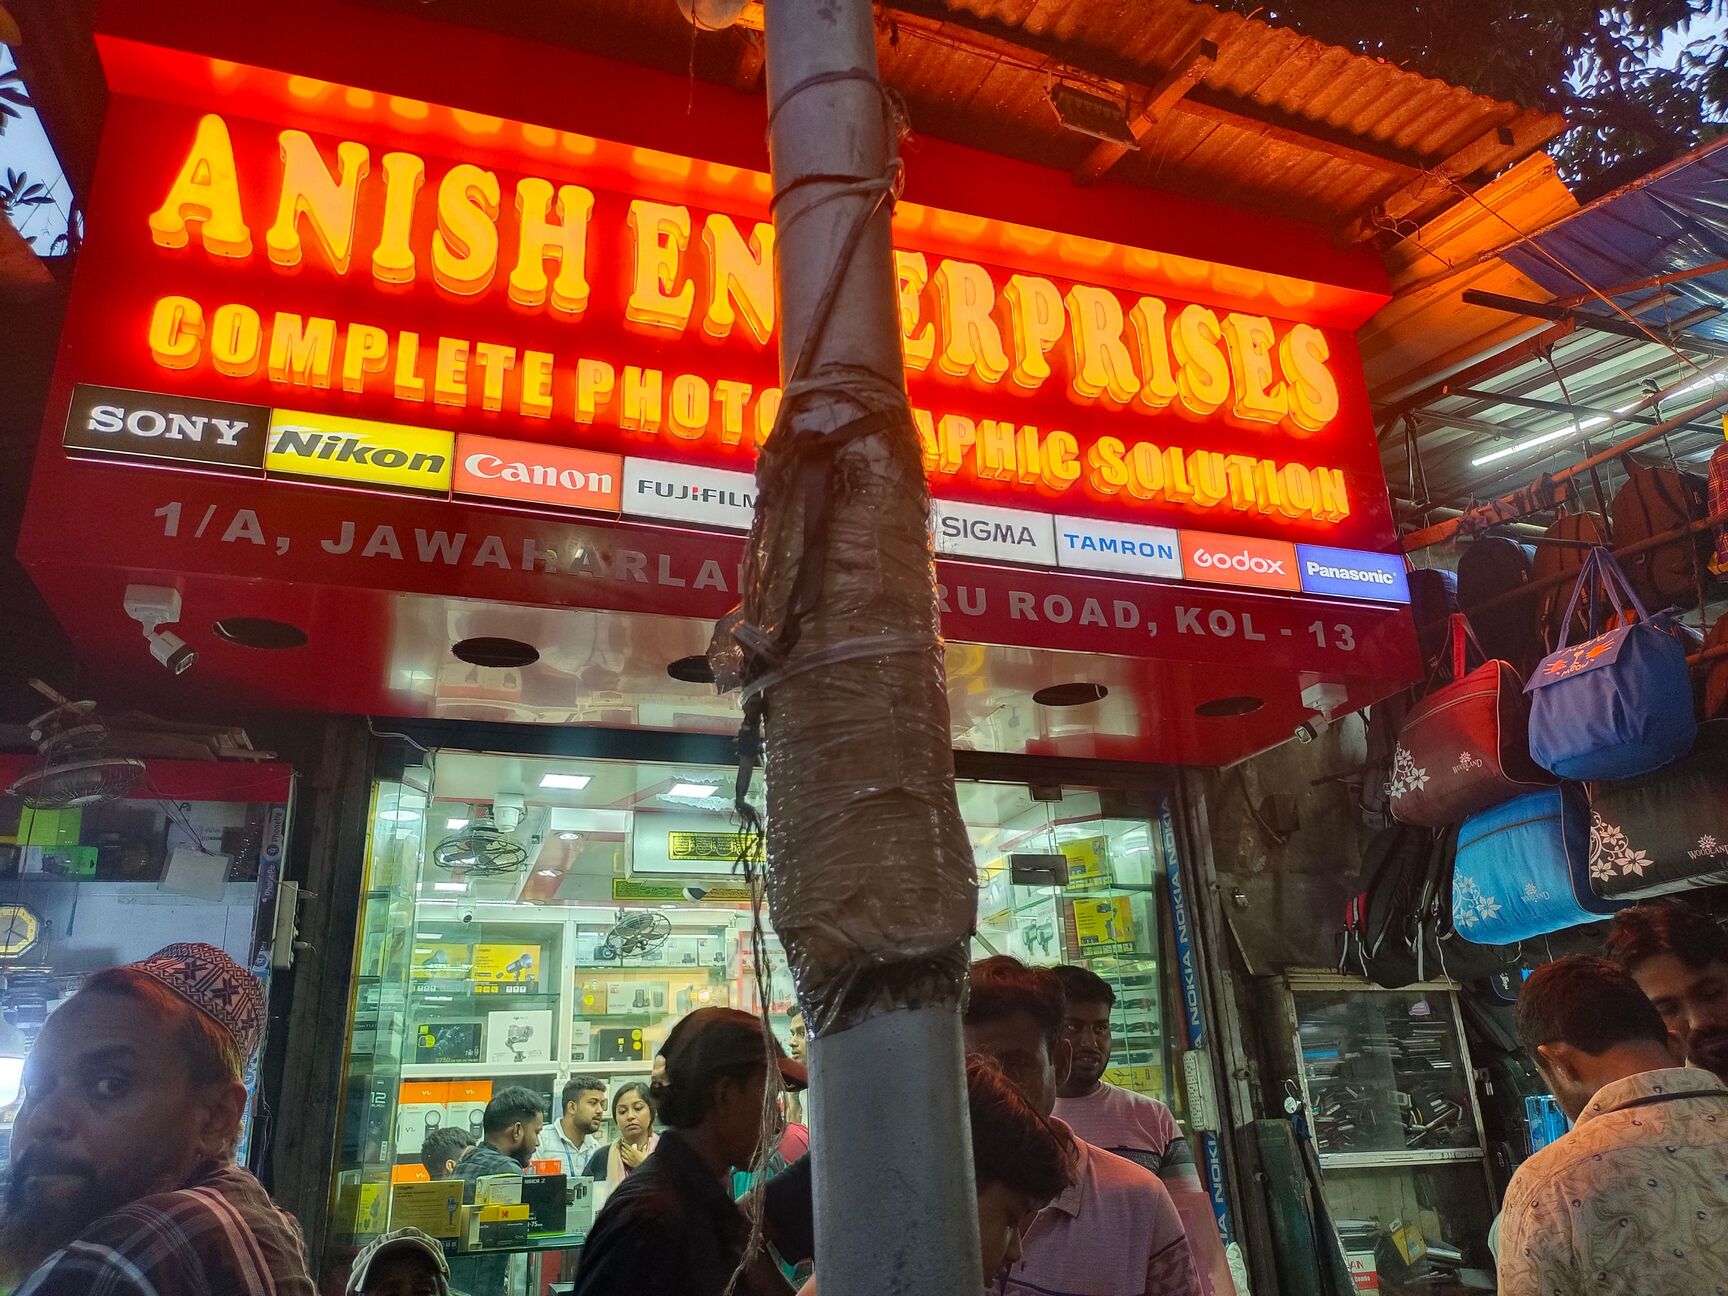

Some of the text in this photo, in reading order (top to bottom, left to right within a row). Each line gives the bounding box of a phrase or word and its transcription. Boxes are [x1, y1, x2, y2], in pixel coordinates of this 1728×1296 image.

[149, 113, 1338, 432] ANISH ENERPRISES
[87, 405, 249, 446] SONY
[149, 296, 554, 418] COMPLETE
[1088, 436, 1350, 523] SOLUTION
[271, 430, 446, 474] Nikon
[464, 453, 612, 494] Canon
[940, 516, 1037, 547] SIGMA
[1063, 533, 1174, 560] TAMRON
[154, 501, 290, 556] 1/A,
[320, 520, 745, 594] JAWAHARLA
[1008, 590, 1158, 637] ROAD,
[1175, 605, 1266, 642] KOL
[1308, 620, 1356, 651] 13
[1193, 548, 1287, 576] Godox
[1306, 561, 1395, 585] Panasonic
[1161, 796, 1178, 865] NOKIA
[1171, 871, 1188, 944] NOKIA
[1182, 950, 1200, 1026] NOKIA
[370, 1091, 387, 1104] 12
